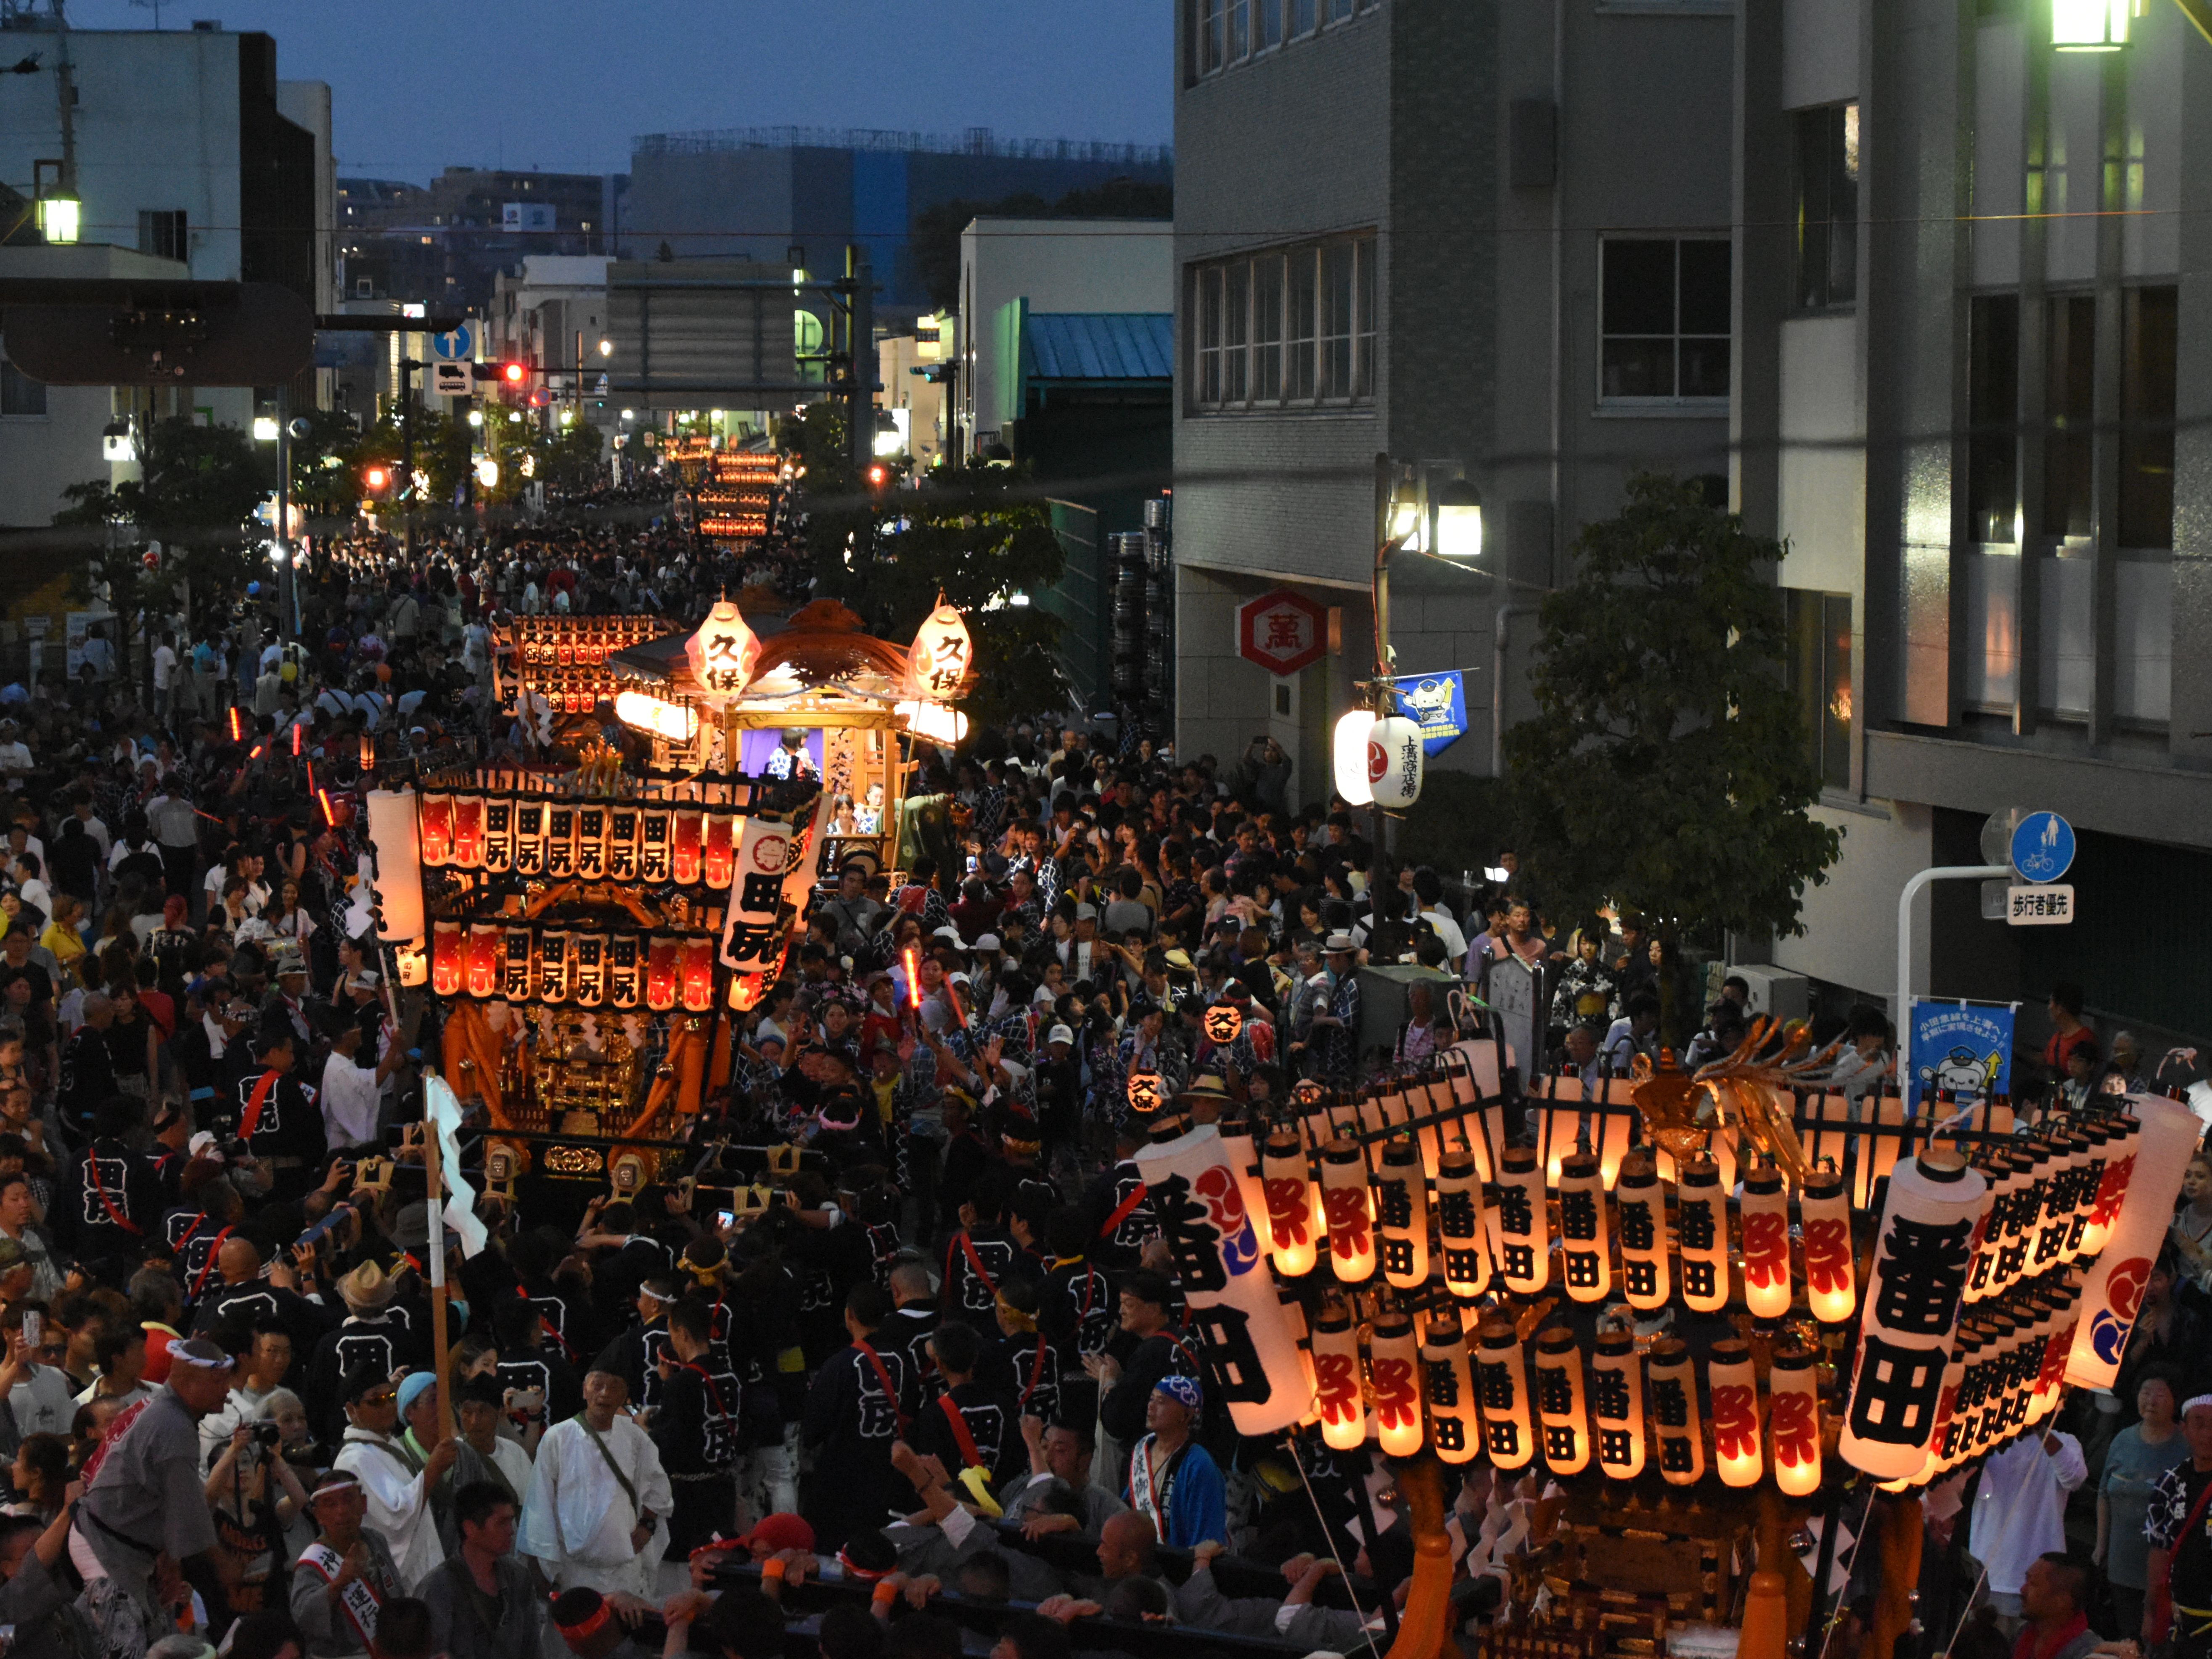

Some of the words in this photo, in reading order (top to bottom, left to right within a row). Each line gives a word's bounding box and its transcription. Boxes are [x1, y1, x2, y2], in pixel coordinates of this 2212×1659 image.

[706, 634, 739, 690] 久保
[930, 636, 963, 690] 久保
[1265, 614, 1302, 649] 萬
[1400, 735, 1418, 798] 上溝商店街
[486, 805, 510, 868] 田尻
[517, 807, 541, 869] 田尻
[550, 810, 573, 873] 田尻
[580, 809, 603, 874] 田尻
[612, 812, 636, 876] 田尻
[644, 814, 667, 879] 田尻
[727, 872, 785, 964] 田尻
[2014, 893, 2067, 917] 歩行者優先
[506, 933, 529, 995] 田尻
[541, 935, 566, 998] 田尻
[579, 939, 601, 1001] 田尻
[614, 940, 636, 1004] 田尻
[1209, 1012, 1238, 1040] 久保
[1131, 1079, 1157, 1109] 久保
[1263, 1177, 1308, 1250] 祭
[1325, 1186, 1369, 1259] 祭
[1742, 1212, 1787, 1289] 祭
[1804, 1218, 1850, 1294] 祭
[1316, 1353, 1357, 1426] 祭
[1373, 1358, 1416, 1430] 祭
[1711, 1384, 1757, 1461] 祭
[1771, 1391, 1815, 1469] 祭
[319, 1551, 378, 1628] 神運行
